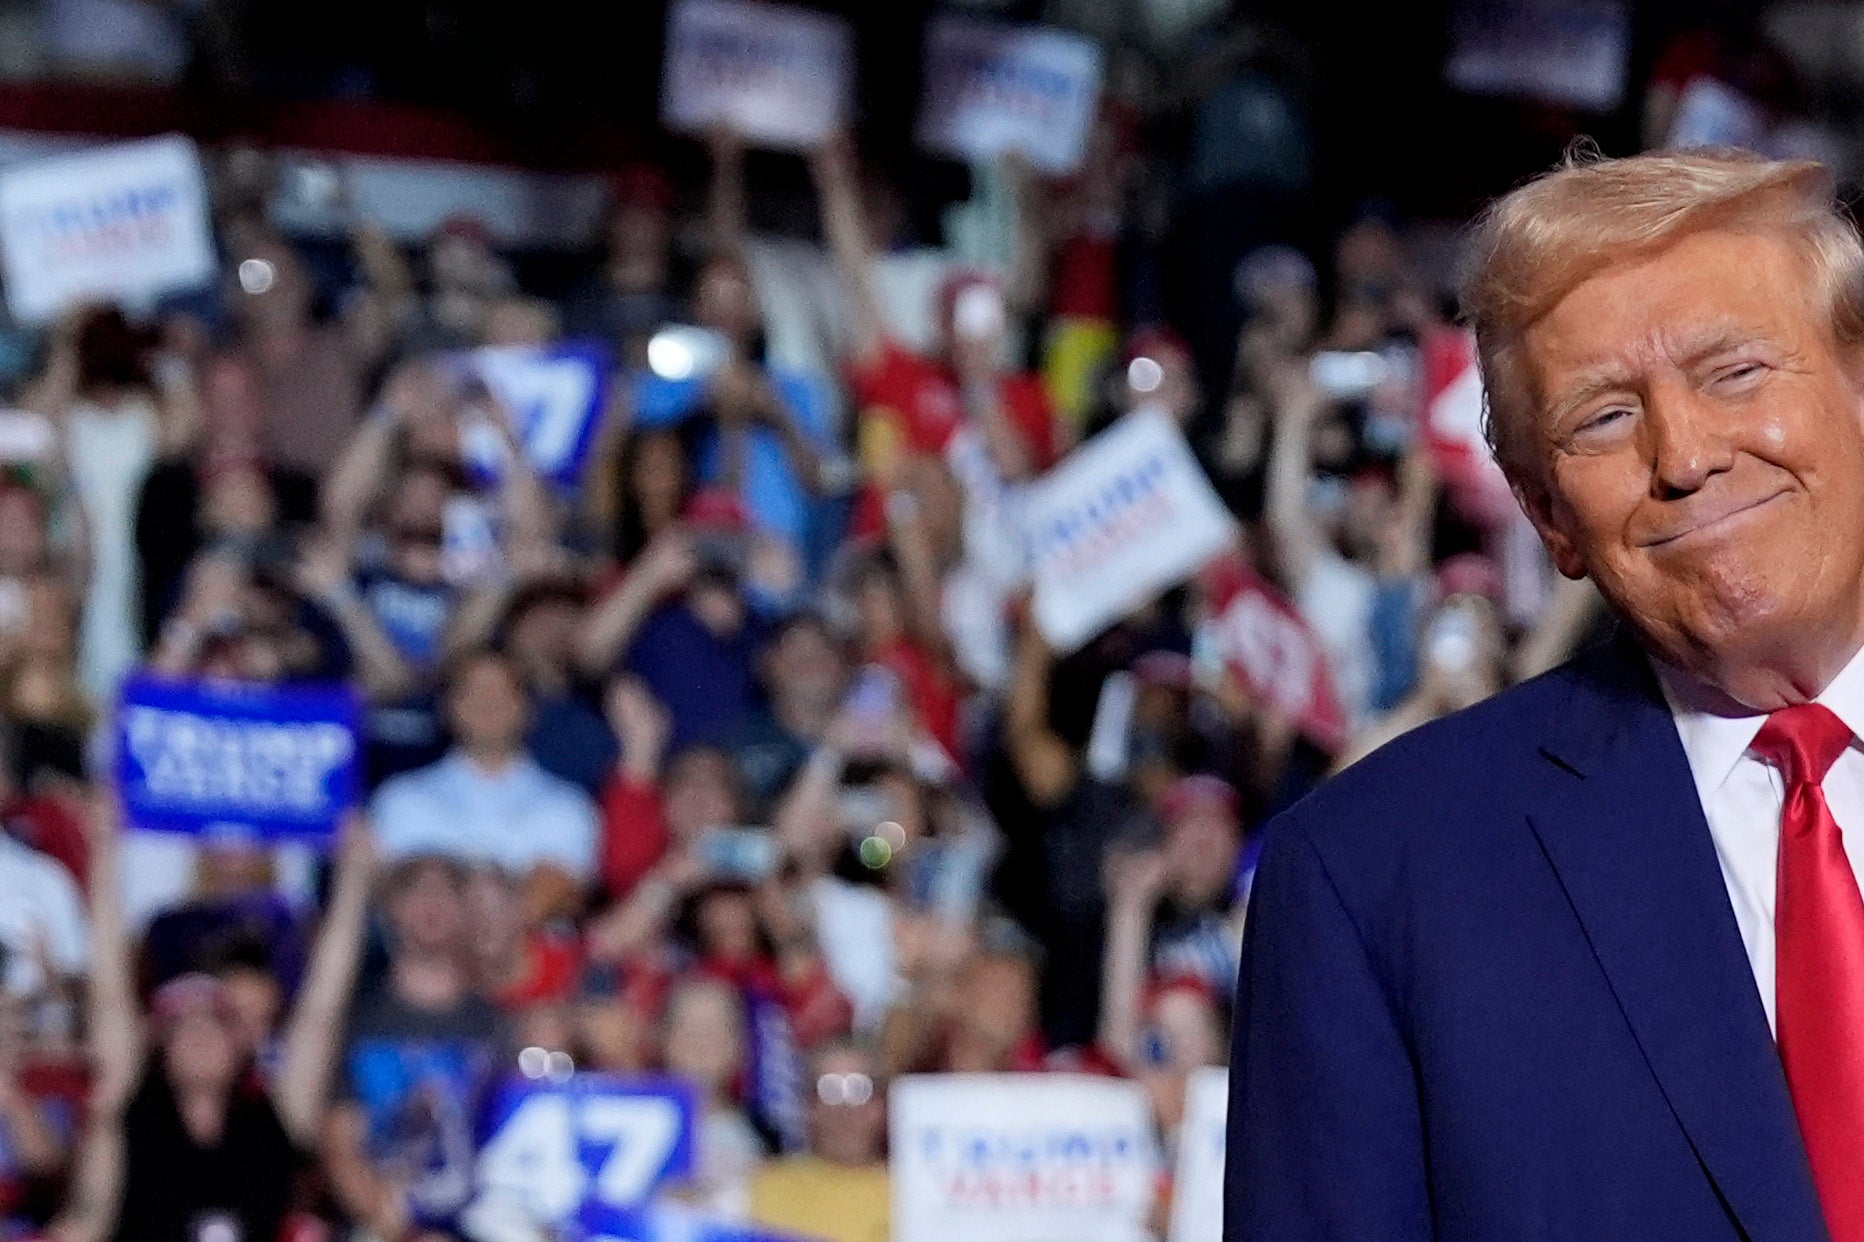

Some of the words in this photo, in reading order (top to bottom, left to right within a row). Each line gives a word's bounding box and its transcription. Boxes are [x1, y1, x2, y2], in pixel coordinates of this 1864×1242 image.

[127, 704, 356, 768] TRUMP
[476, 1094, 681, 1206] 47
[920, 1129, 1131, 1165] TRUMP
[944, 1167, 1116, 1209] VANCE
